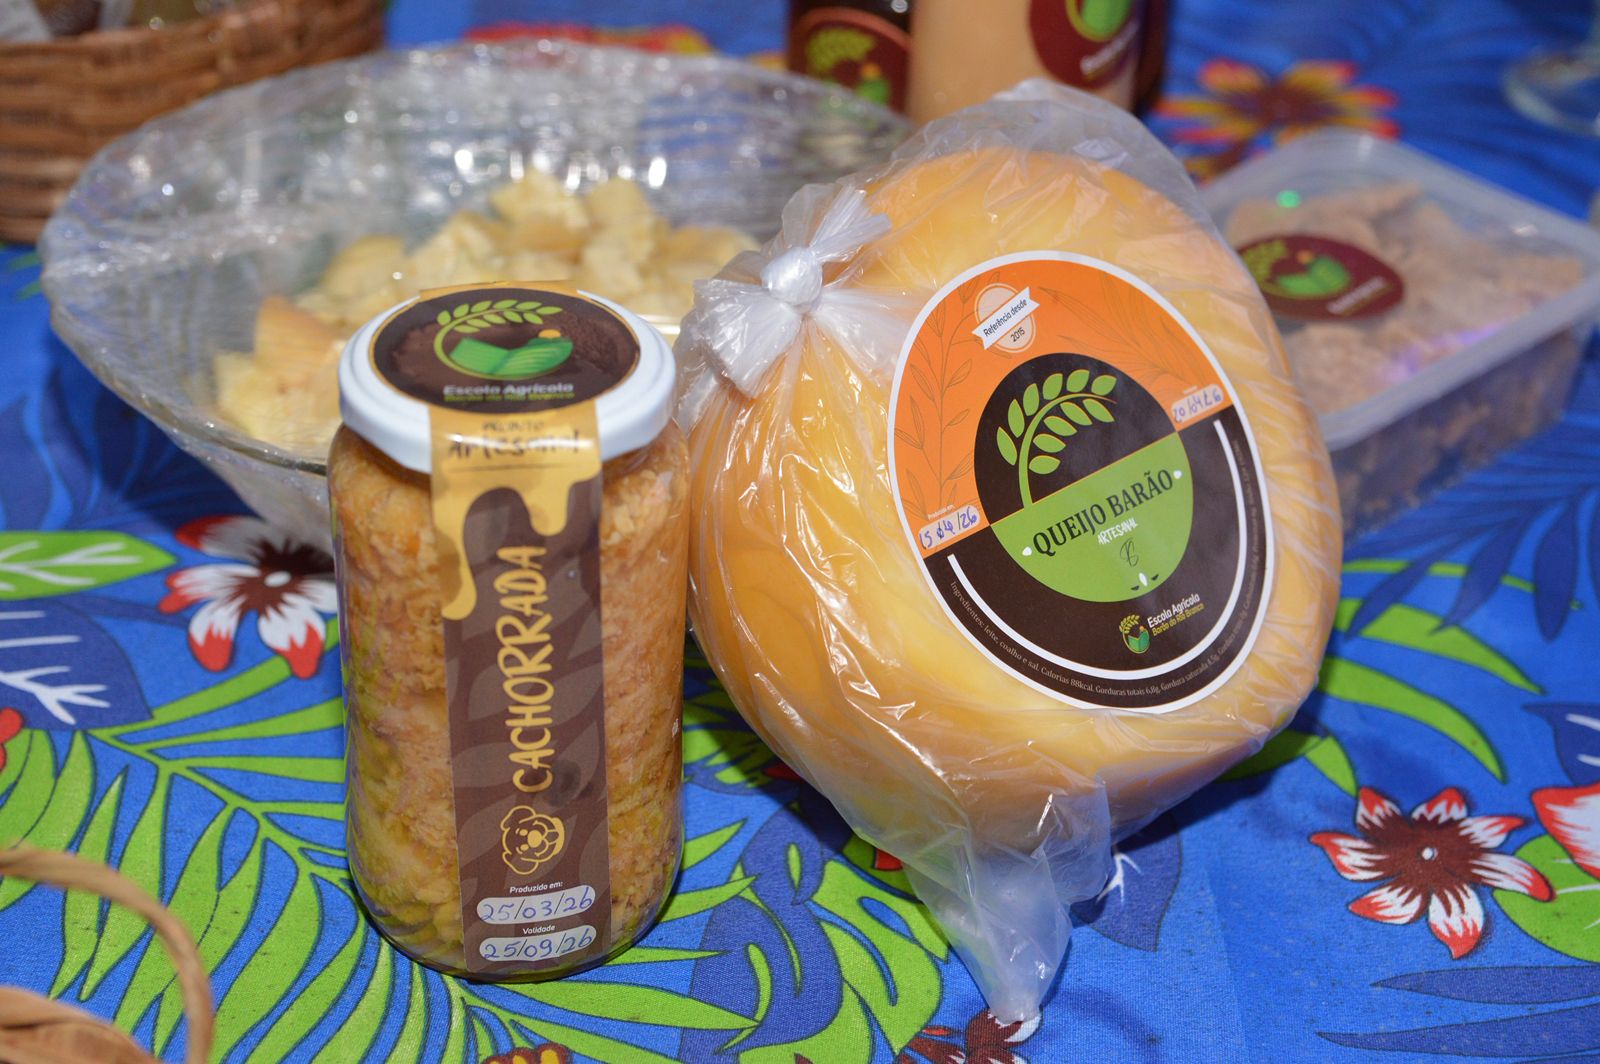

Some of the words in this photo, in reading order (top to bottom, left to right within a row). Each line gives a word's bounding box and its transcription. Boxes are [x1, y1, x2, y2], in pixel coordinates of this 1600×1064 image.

[983, 311, 1012, 337] Referência
[1010, 299, 1028, 316] desde
[1010, 326, 1026, 343] 2015
[443, 384, 501, 395] Escola
[1032, 503, 1107, 557] QUEIJO
[1106, 469, 1173, 518] BARÃO
[1147, 609, 1173, 628] Escola
[1171, 593, 1200, 616] Agrícola
[950, 581, 985, 628] Ingredientes:
[983, 625, 999, 644] leite,
[999, 641, 1022, 660] coalho
[1022, 655, 1028, 663] e
[1027, 660, 1040, 672] sal.
[1040, 666, 1070, 685] Calorias
[1095, 685, 1127, 696] Gorduras
[1127, 688, 1146, 696] totais
[1160, 678, 1186, 691] Gordura
[493, 545, 555, 793] CACHORRADA
[480, 886, 593, 921] 25/03/26
[509, 884, 548, 894] Produzido
[549, 881, 564, 889] em:
[484, 927, 593, 958] 25/09/26
[522, 924, 556, 935] Validade
